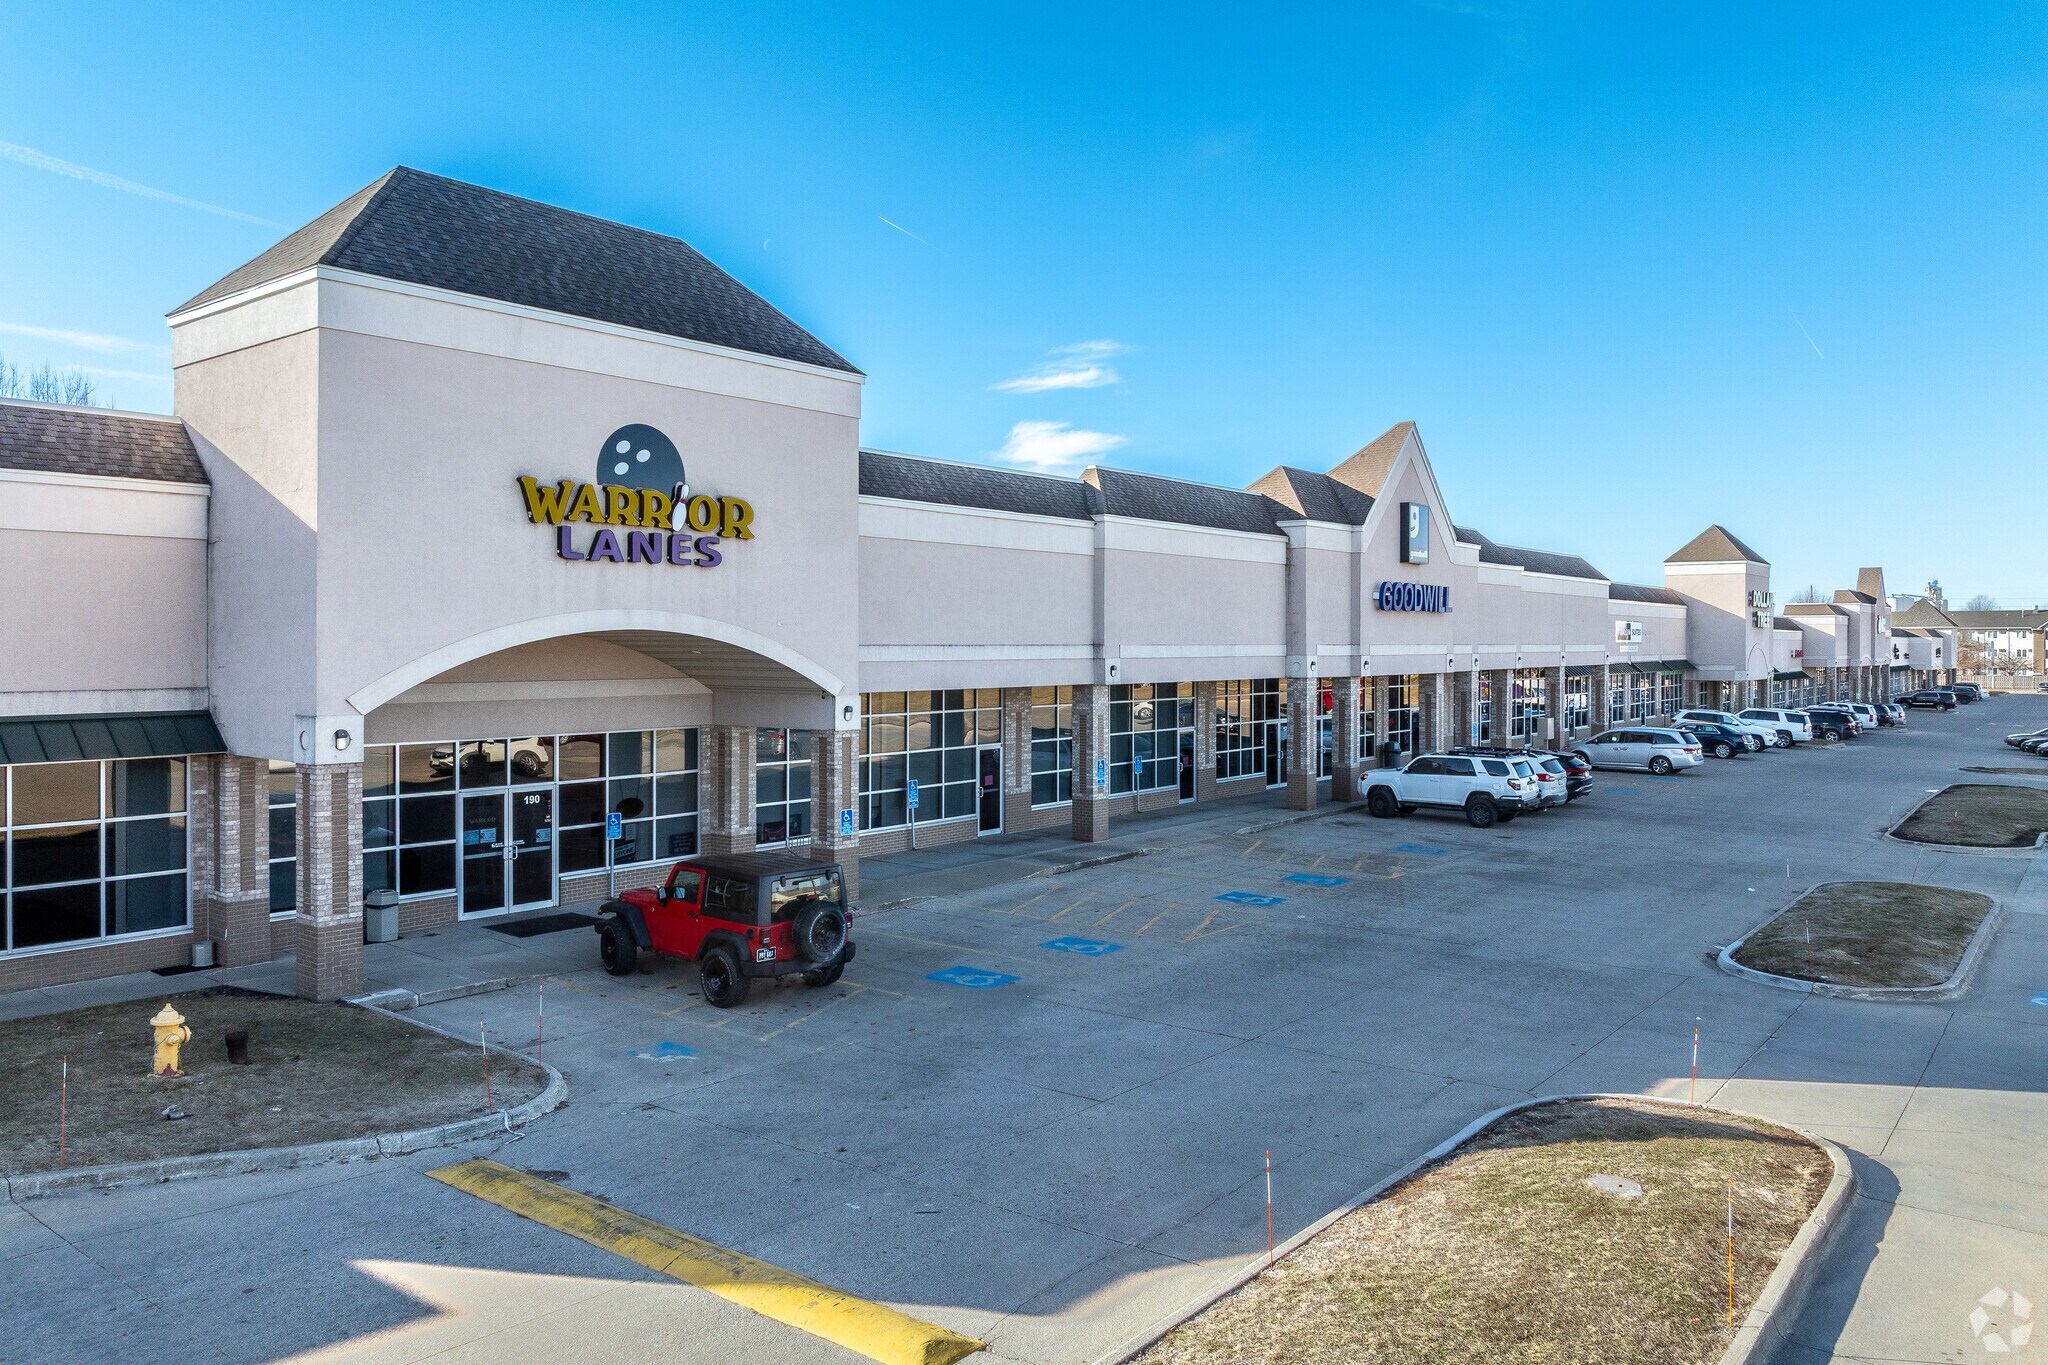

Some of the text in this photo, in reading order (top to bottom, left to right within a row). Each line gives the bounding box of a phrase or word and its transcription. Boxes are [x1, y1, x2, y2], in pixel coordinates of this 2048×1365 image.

[517, 476, 755, 539] WARRIOR
[557, 526, 723, 567] LANES
[1380, 581, 1453, 612] GOODWILL
[1752, 590, 1776, 608] DOLLAR
[523, 795, 541, 805] 190
